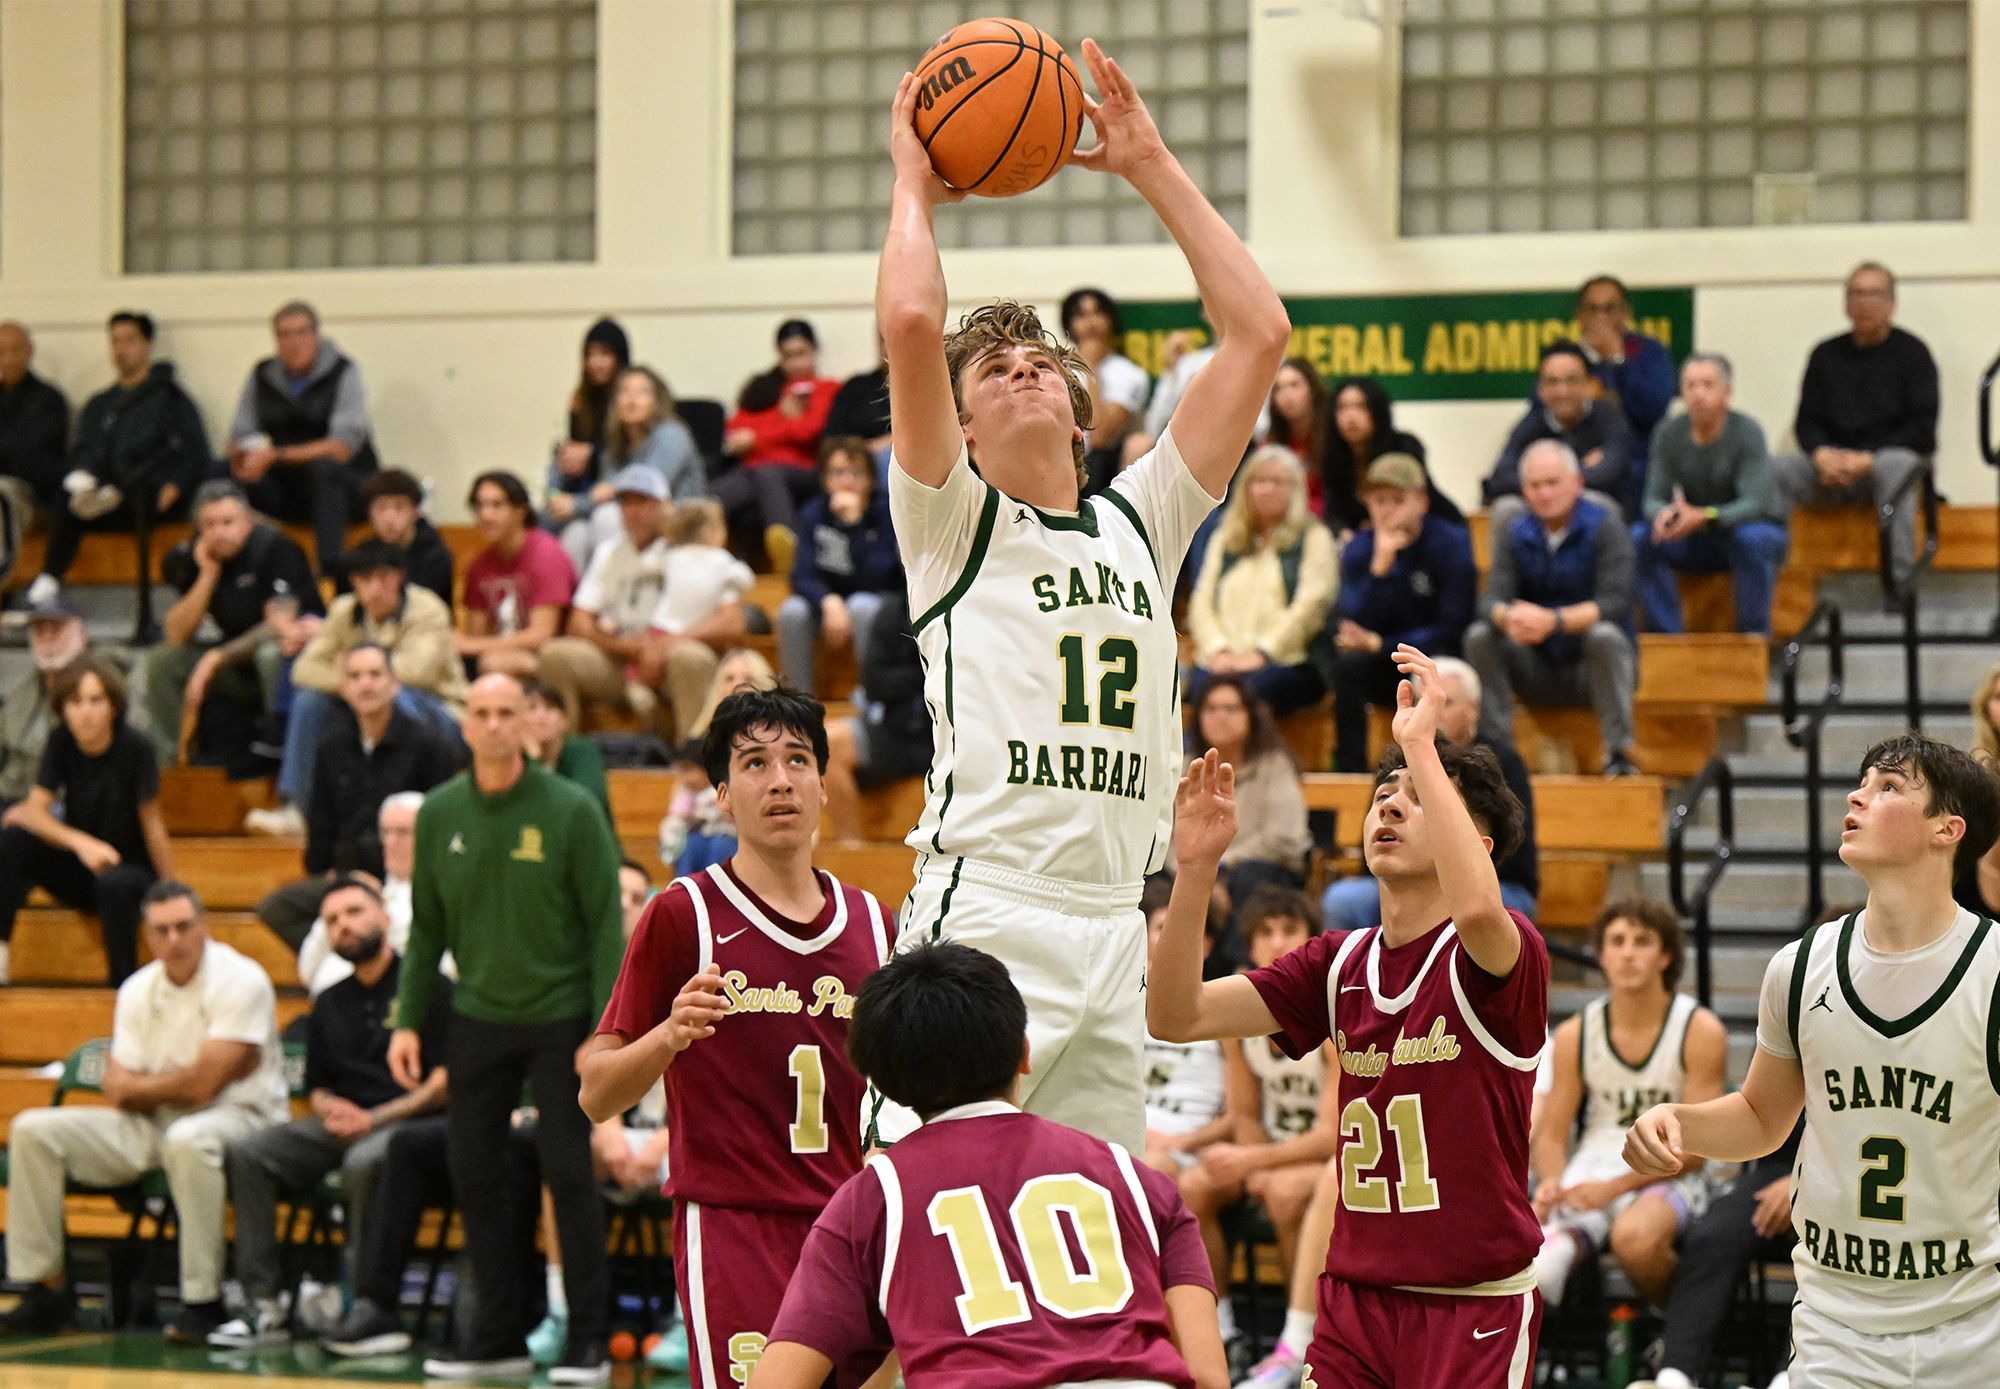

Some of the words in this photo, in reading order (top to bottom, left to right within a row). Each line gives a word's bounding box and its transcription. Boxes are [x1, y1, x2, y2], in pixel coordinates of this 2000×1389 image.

[1032, 560, 1154, 621] SANTA
[1056, 632, 1139, 733] 12
[719, 970, 803, 1015] Santa
[1392, 1015, 1461, 1066] aula
[788, 1044, 829, 1154] 1
[1824, 1065, 1954, 1124] SANTA
[1340, 1093, 1440, 1213] 21
[1857, 1134, 1909, 1225] 2
[926, 1173, 1134, 1337] 10
[1804, 1219, 1975, 1281] BARBARA
